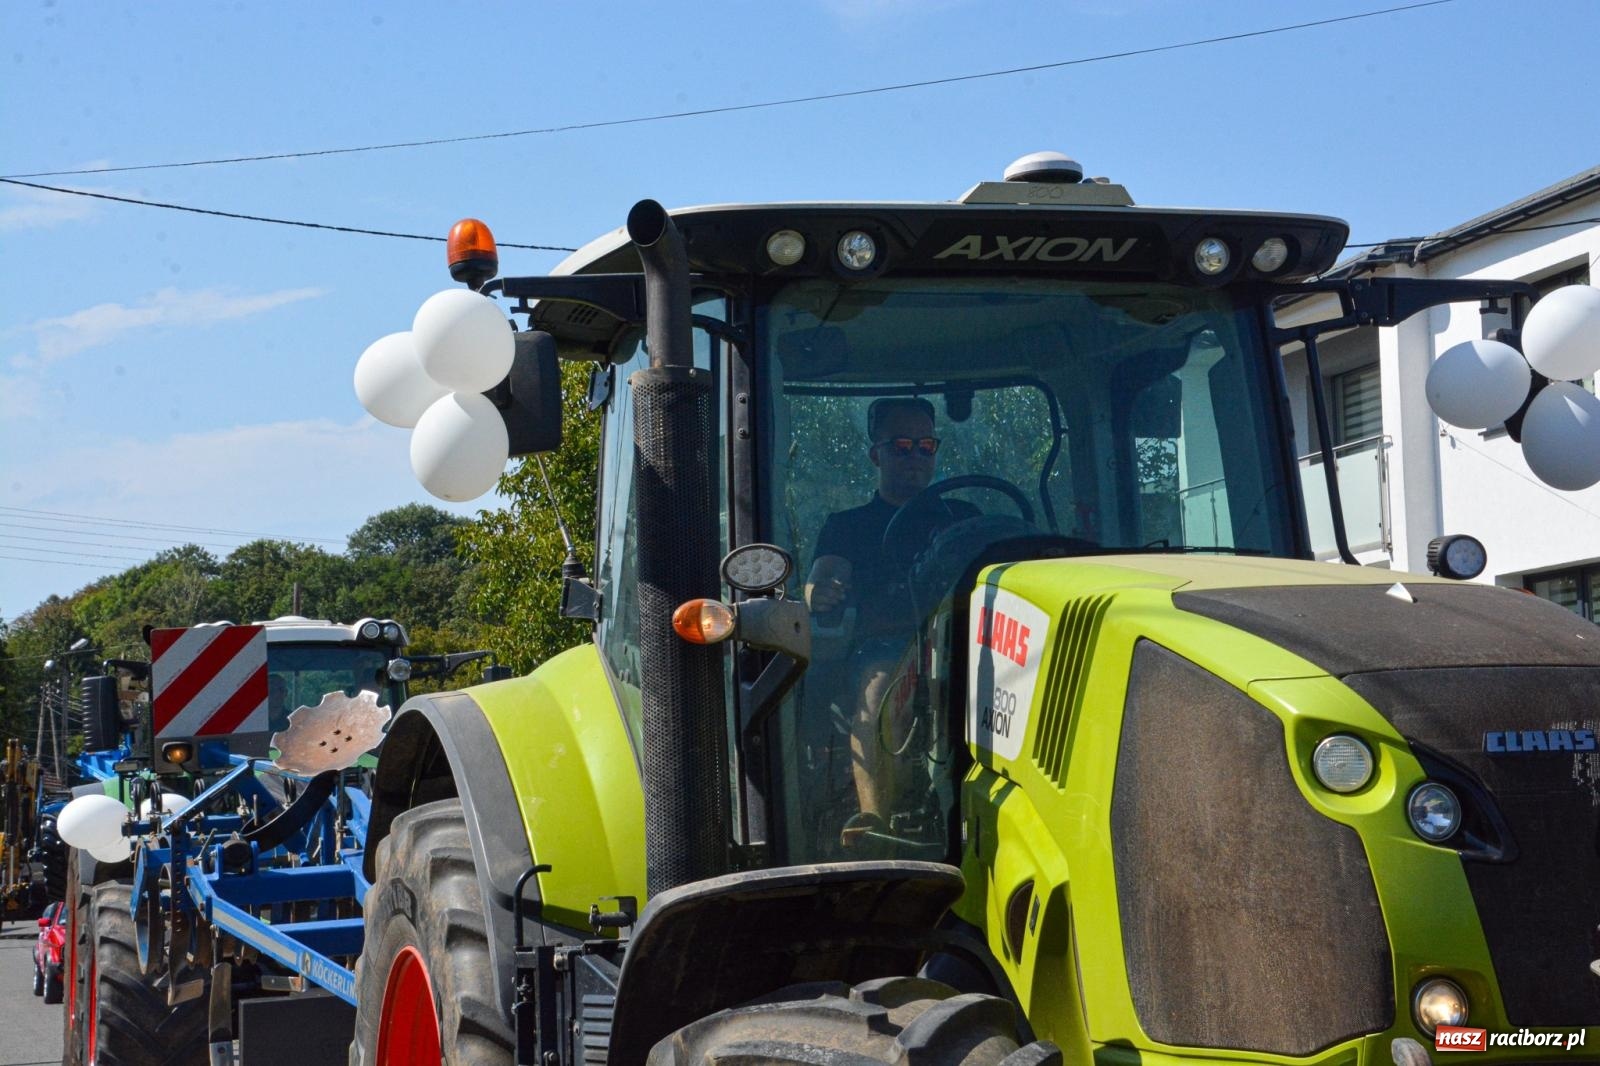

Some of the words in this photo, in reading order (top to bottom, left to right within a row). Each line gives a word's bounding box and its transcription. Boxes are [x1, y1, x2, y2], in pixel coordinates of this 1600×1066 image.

[933, 234, 1138, 262] AXION
[976, 606, 1031, 668] CLAAS
[993, 687, 1017, 716] 800
[981, 706, 1011, 739] AXION
[1486, 729, 1596, 752] CLAAS
[312, 958, 358, 1000] KÖCKERLIN
